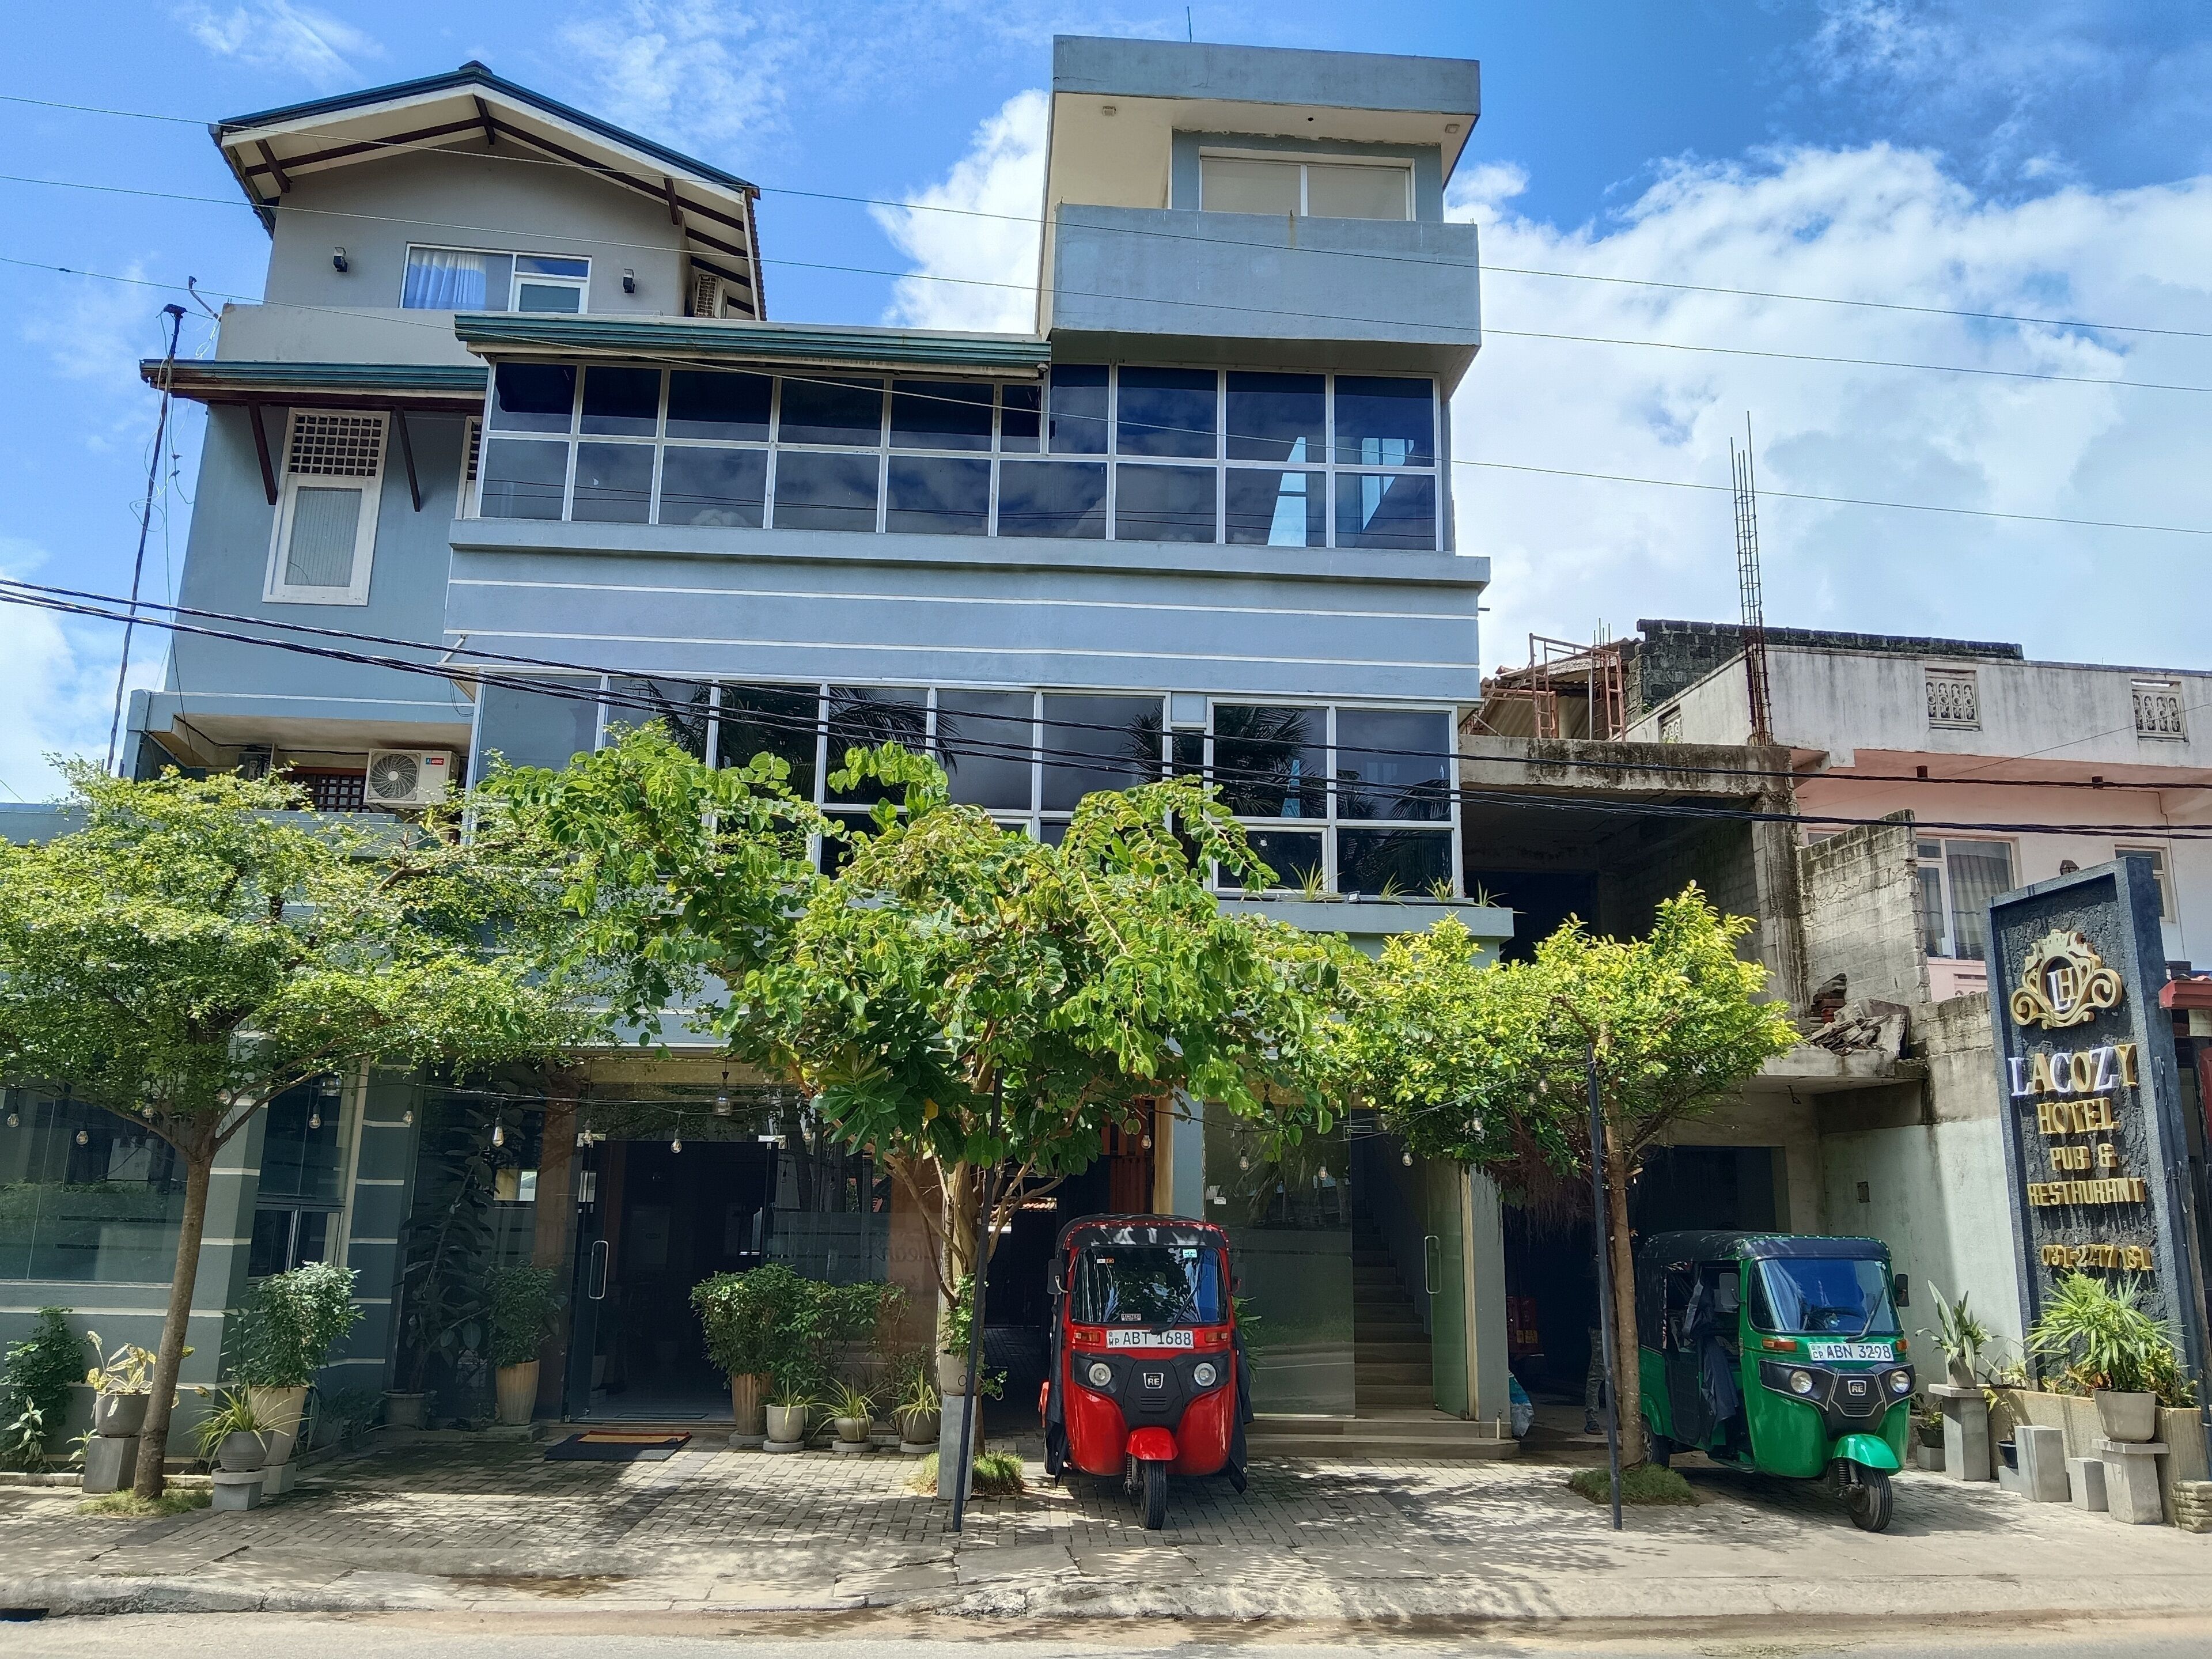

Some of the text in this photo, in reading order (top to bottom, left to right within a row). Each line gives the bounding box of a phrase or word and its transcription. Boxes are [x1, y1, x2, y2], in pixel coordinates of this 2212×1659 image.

[2008, 1043, 2137, 1096] LACOZY
[2036, 1097, 2120, 1134] HOTEL
[2050, 1143, 2116, 1170] PUB &
[2027, 1177, 2146, 1206] RESTAURANT
[1123, 1331, 1151, 1344] ABT
[1157, 1332, 1191, 1346] 1688
[1827, 1345, 1853, 1358] ABN
